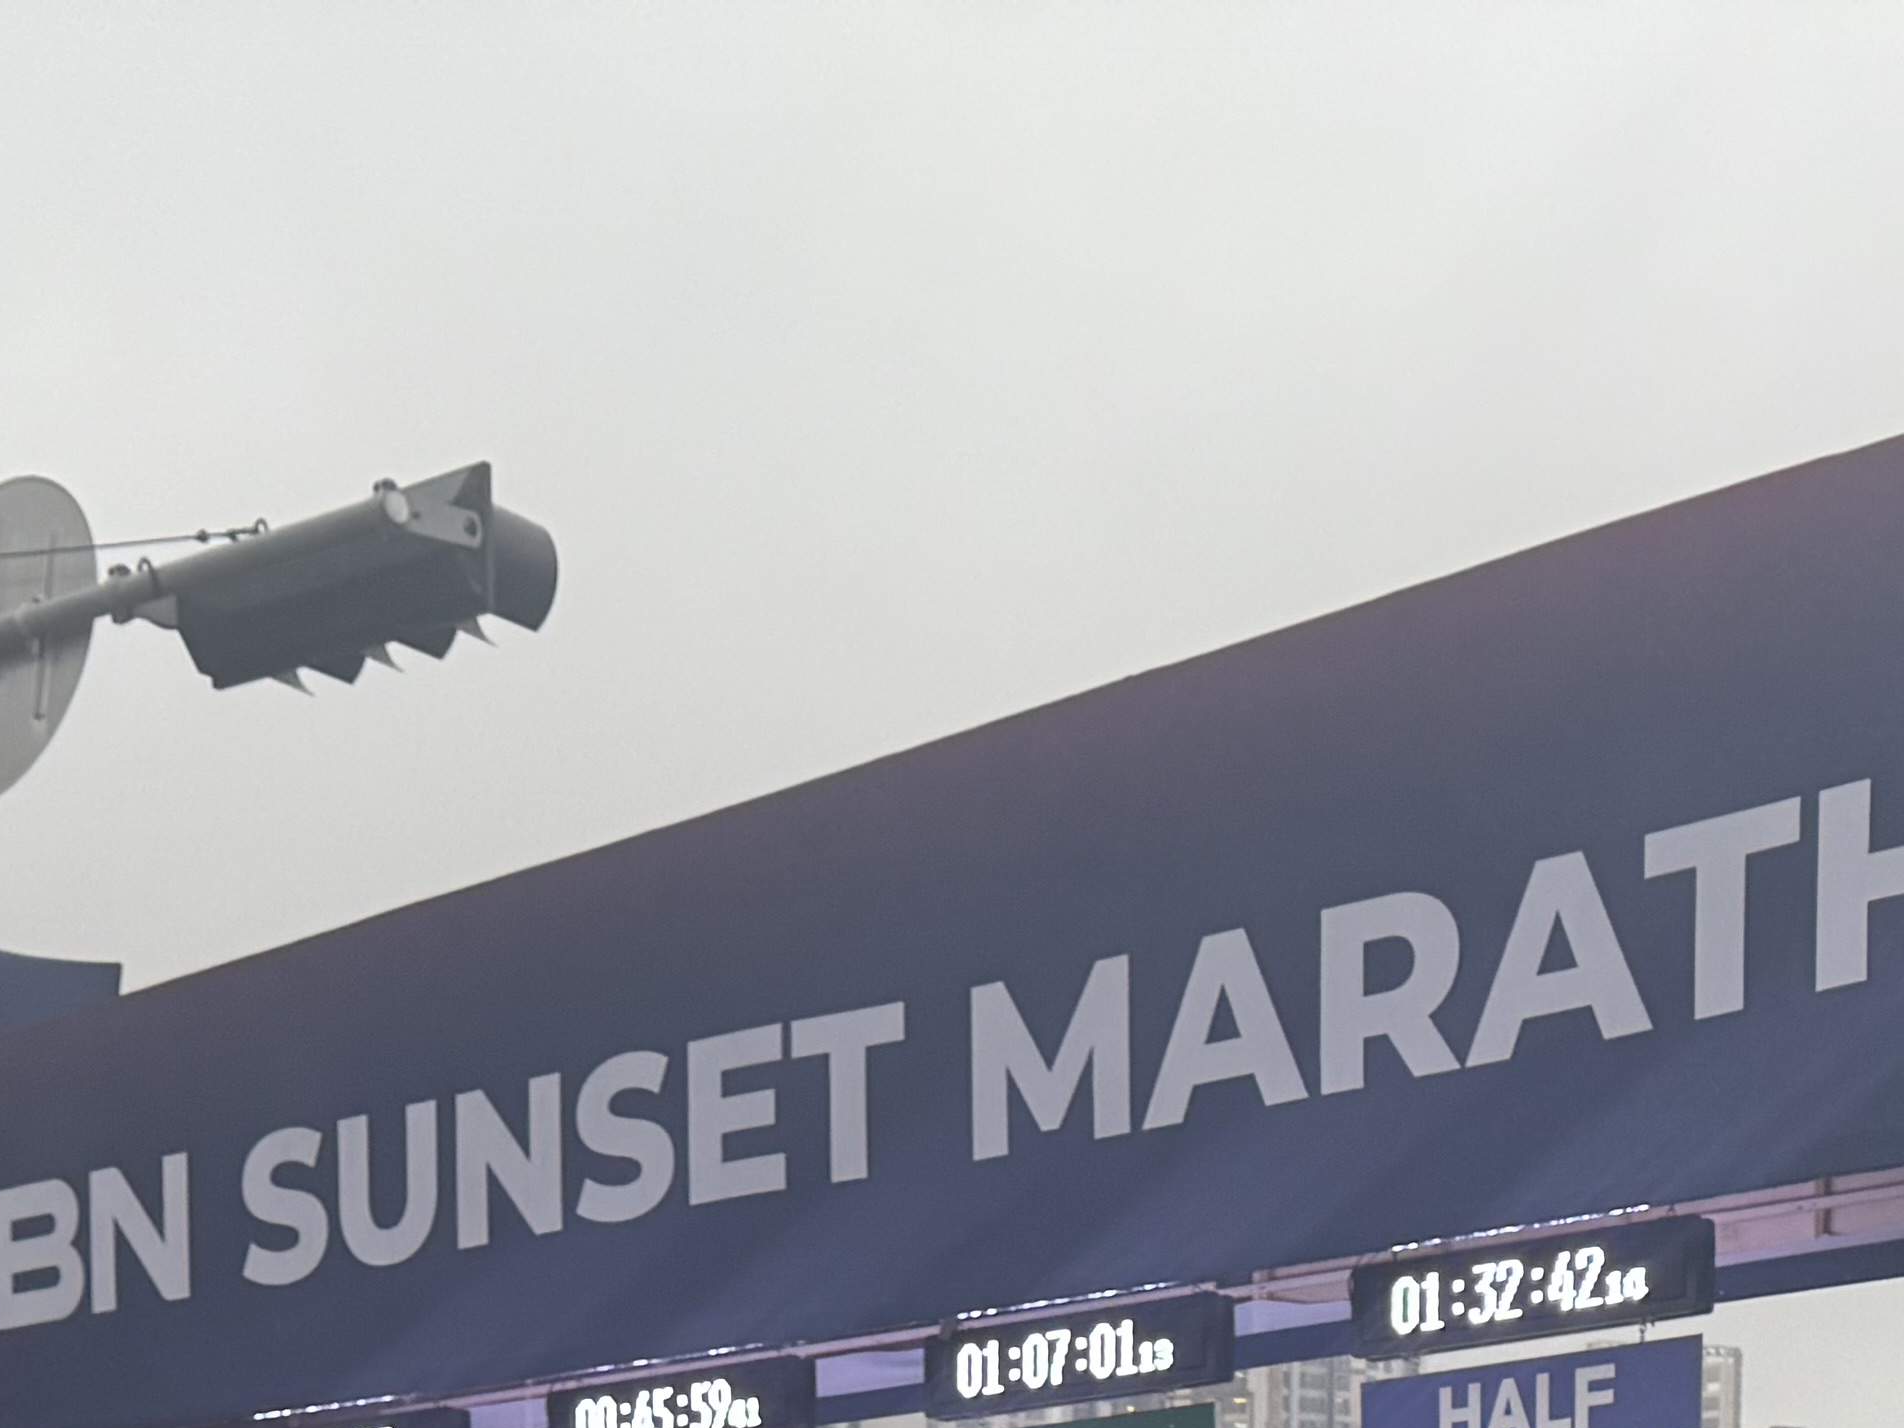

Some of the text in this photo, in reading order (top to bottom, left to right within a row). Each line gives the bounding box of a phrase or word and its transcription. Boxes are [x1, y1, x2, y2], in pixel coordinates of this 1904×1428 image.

[241, 1000, 906, 1286] SUNSET
[1391, 1246, 1605, 1335] 01:32:42
[956, 1318, 1138, 1399] 01:07:01
